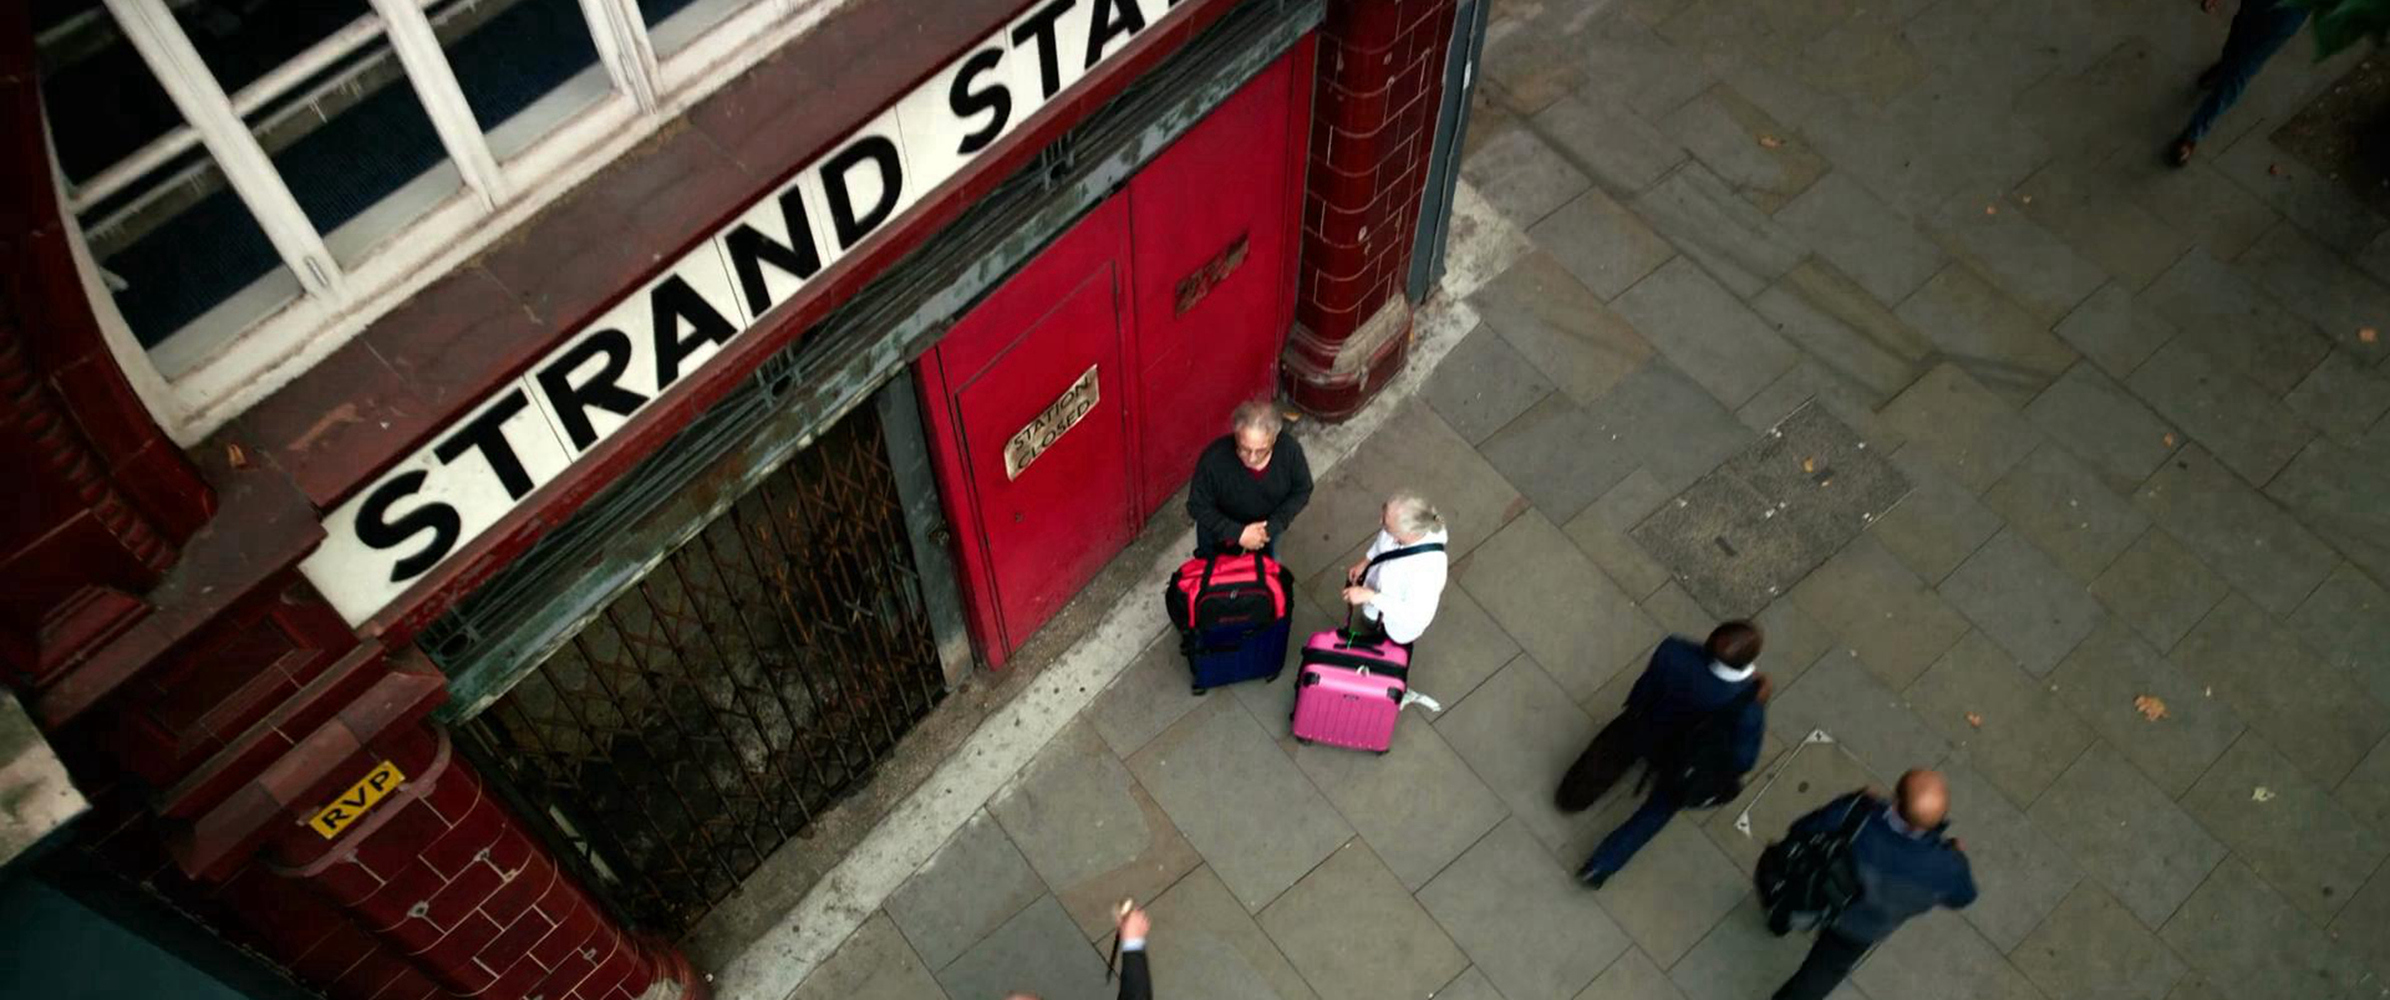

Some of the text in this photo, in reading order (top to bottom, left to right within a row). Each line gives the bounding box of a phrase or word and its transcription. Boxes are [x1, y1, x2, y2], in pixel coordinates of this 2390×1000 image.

[355, 0, 1183, 584] STRAND STA
[1013, 376, 1089, 450] STATION
[1017, 400, 1090, 469] CLOSED
[321, 770, 390, 829] RVP
